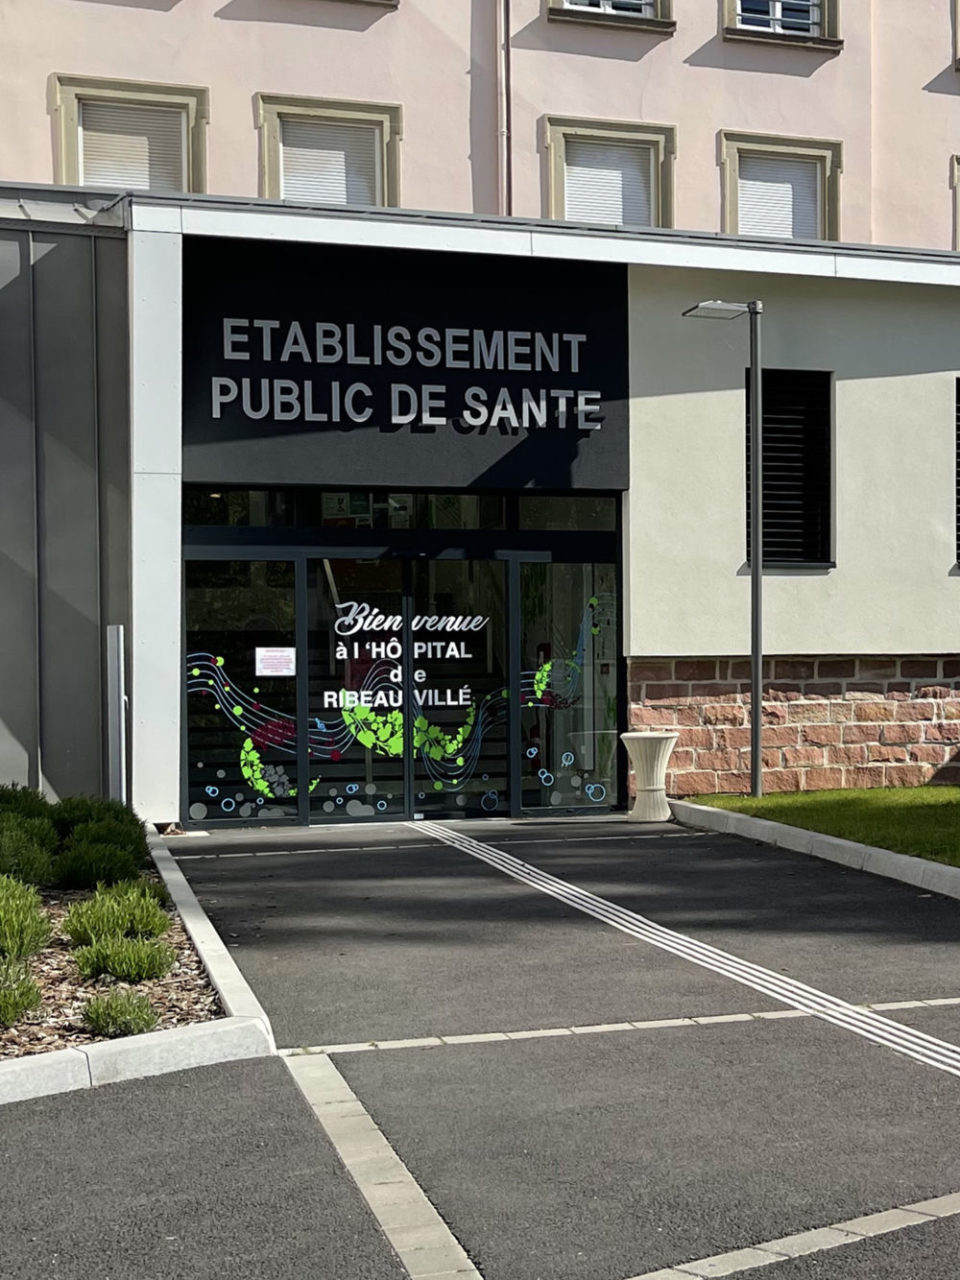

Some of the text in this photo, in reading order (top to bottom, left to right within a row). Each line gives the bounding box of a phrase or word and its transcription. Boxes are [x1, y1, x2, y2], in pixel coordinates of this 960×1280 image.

[222, 317, 586, 373] ETABLISSEMENT
[211, 376, 602, 430] PUBLIC DE SANTE
